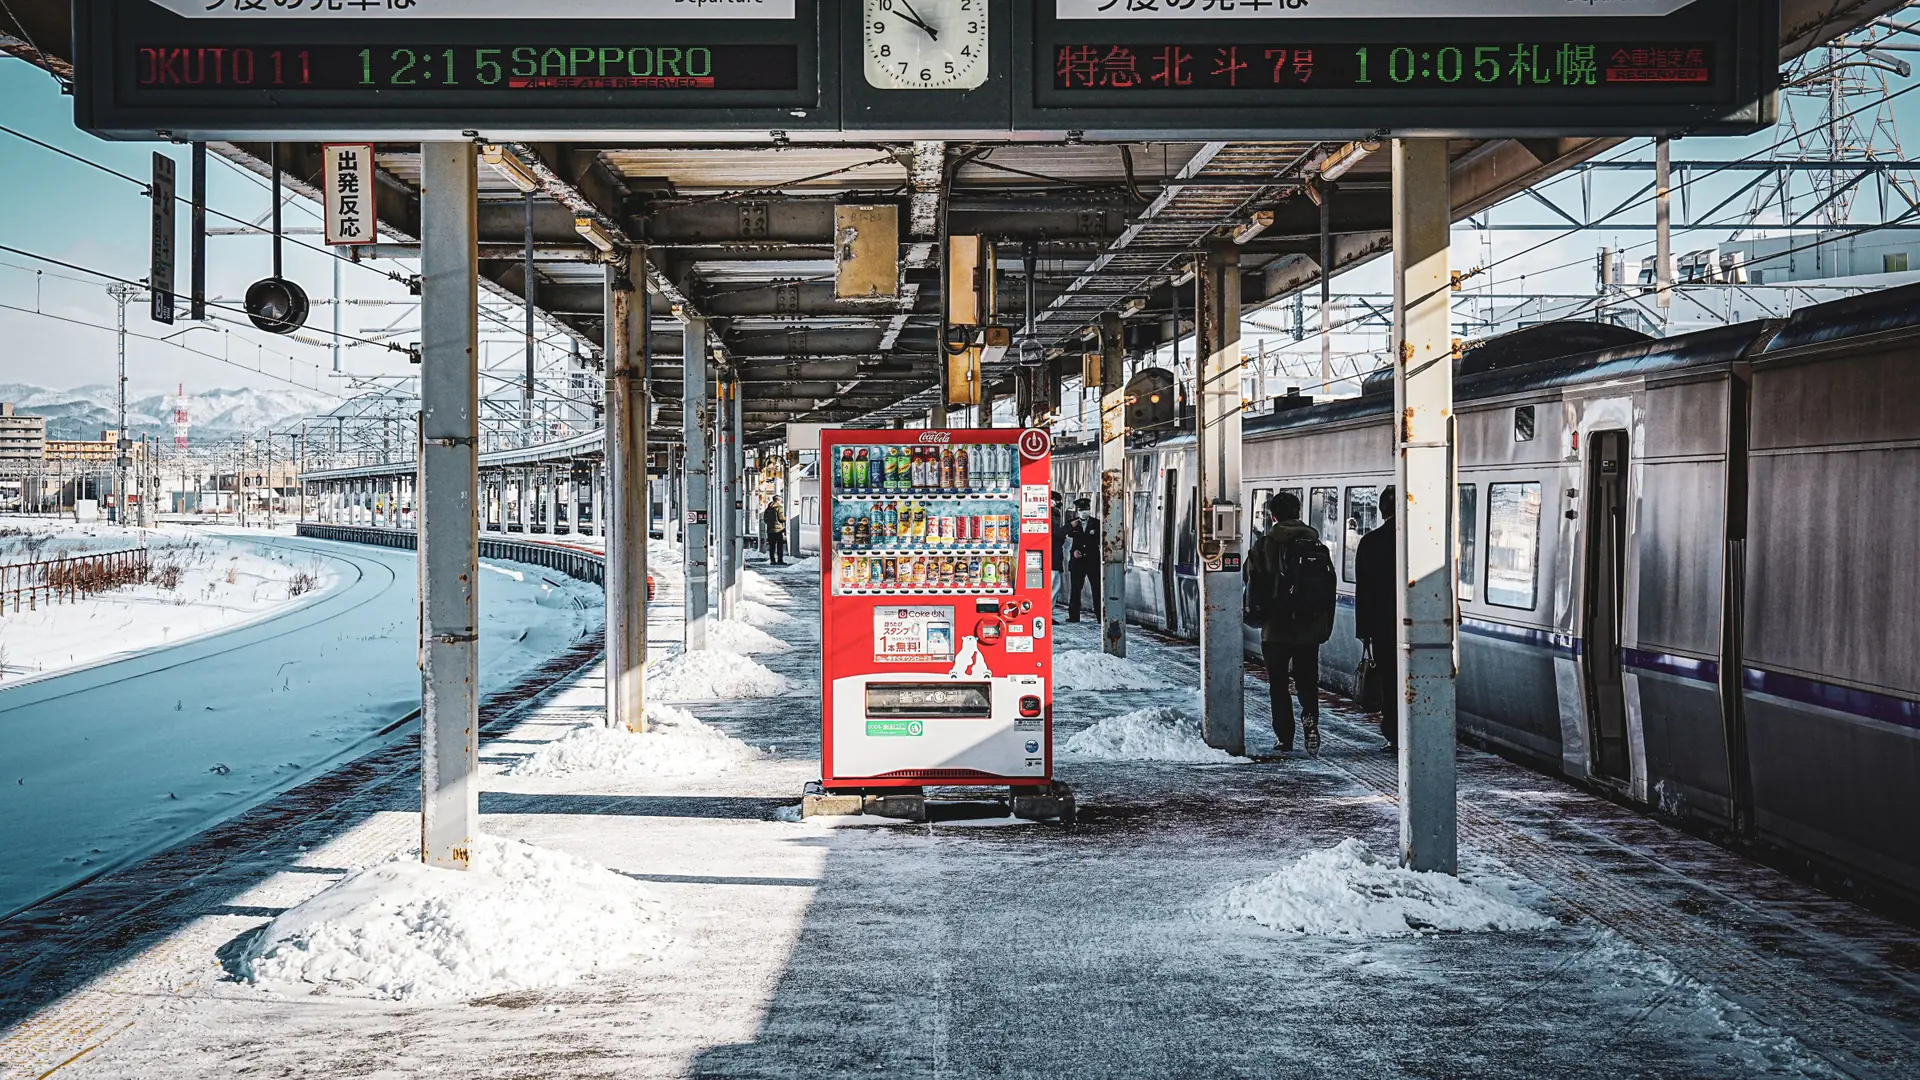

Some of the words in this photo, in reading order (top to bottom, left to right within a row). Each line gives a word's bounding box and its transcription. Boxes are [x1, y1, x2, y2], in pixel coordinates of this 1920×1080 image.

[873, 22, 885, 34] 9
[967, 22, 978, 33] 3
[880, 44, 891, 57] 8
[960, 45, 971, 57] 4
[1611, 47, 1703, 68] 全車指定席
[269, 50, 313, 84] 11
[358, 48, 502, 85] 12:15
[511, 47, 711, 76] SAPPORO
[898, 62, 908, 75] 7
[944, 62, 954, 74] 5
[1355, 47, 1500, 83] 10:05
[1508, 43, 1597, 85] 札幌
[920, 68, 932, 81] 6
[1616, 69, 1699, 80] RESERVED
[616, 78, 698, 88] RESERVED
[337, 150, 361, 238] 出発反応
[908, 610, 930, 618] Coke
[883, 627, 910, 636] スタンプ
[880, 636, 921, 653] 1本無料!
